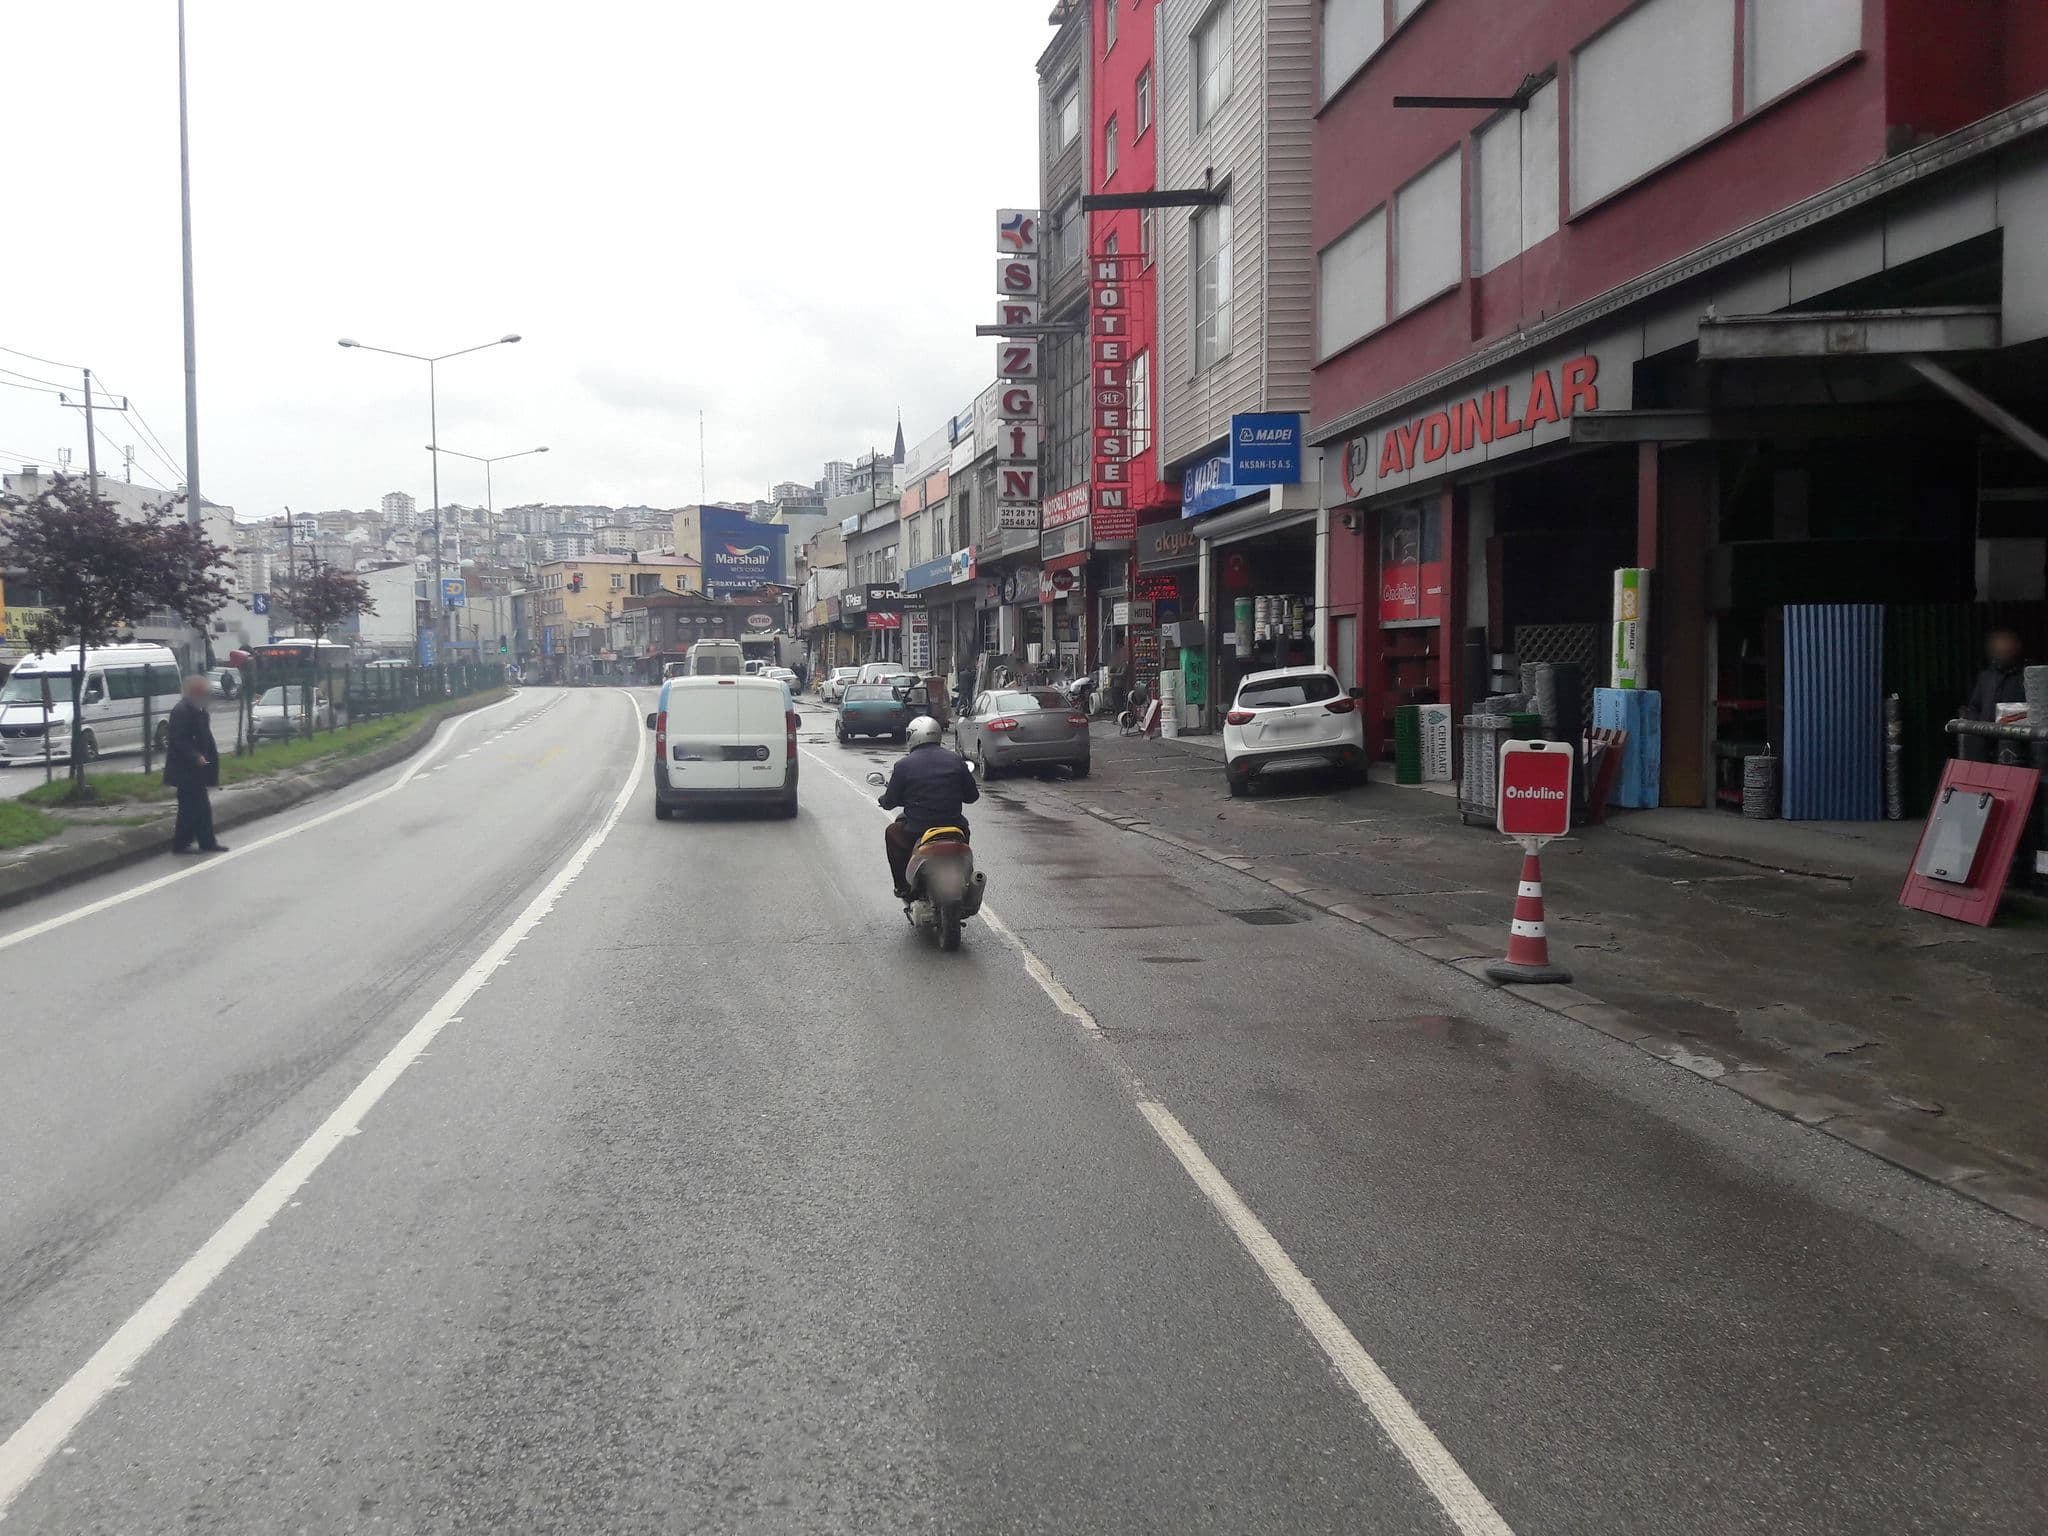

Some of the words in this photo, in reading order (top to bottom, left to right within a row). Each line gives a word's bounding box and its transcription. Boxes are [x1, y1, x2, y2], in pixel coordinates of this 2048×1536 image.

[1100, 262, 1118, 386] HOTEL
[1378, 354, 1599, 479] AYDINLAR
[1256, 429, 1292, 440] MAPEI
[1102, 410, 1122, 507] ESEN
[1194, 459, 1220, 498] MAPEI
[1001, 509, 1014, 517] 321
[1016, 509, 1026, 517] 28
[1027, 509, 1036, 517] 71
[1001, 518, 1014, 526] 325
[1015, 518, 1025, 526] 48
[1026, 518, 1036, 527] 34
[715, 553, 766, 565] Marshall
[1505, 785, 1565, 800] Onduline
